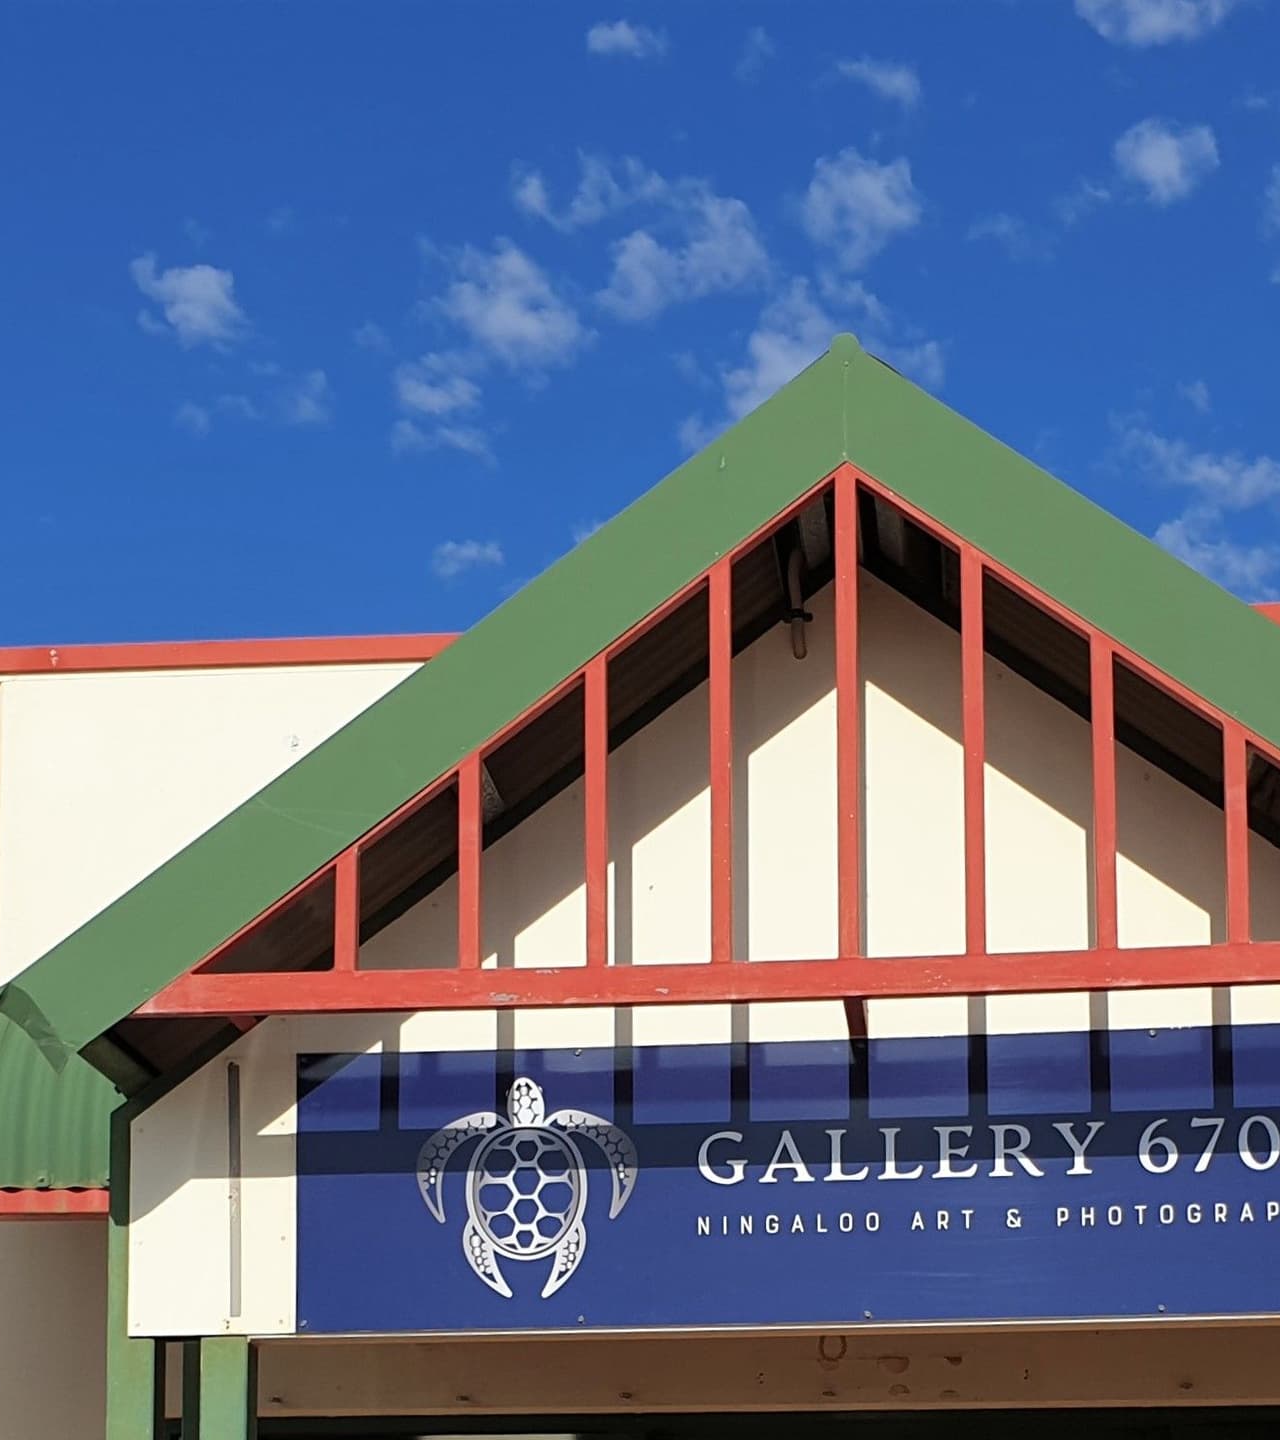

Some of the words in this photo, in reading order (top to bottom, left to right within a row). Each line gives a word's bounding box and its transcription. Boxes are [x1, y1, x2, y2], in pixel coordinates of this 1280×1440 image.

[697, 1121, 1106, 1186] GALLERY
[696, 1211, 881, 1236] NINGALOO
[910, 1209, 975, 1232] ART
[1005, 1208, 1022, 1229] &
